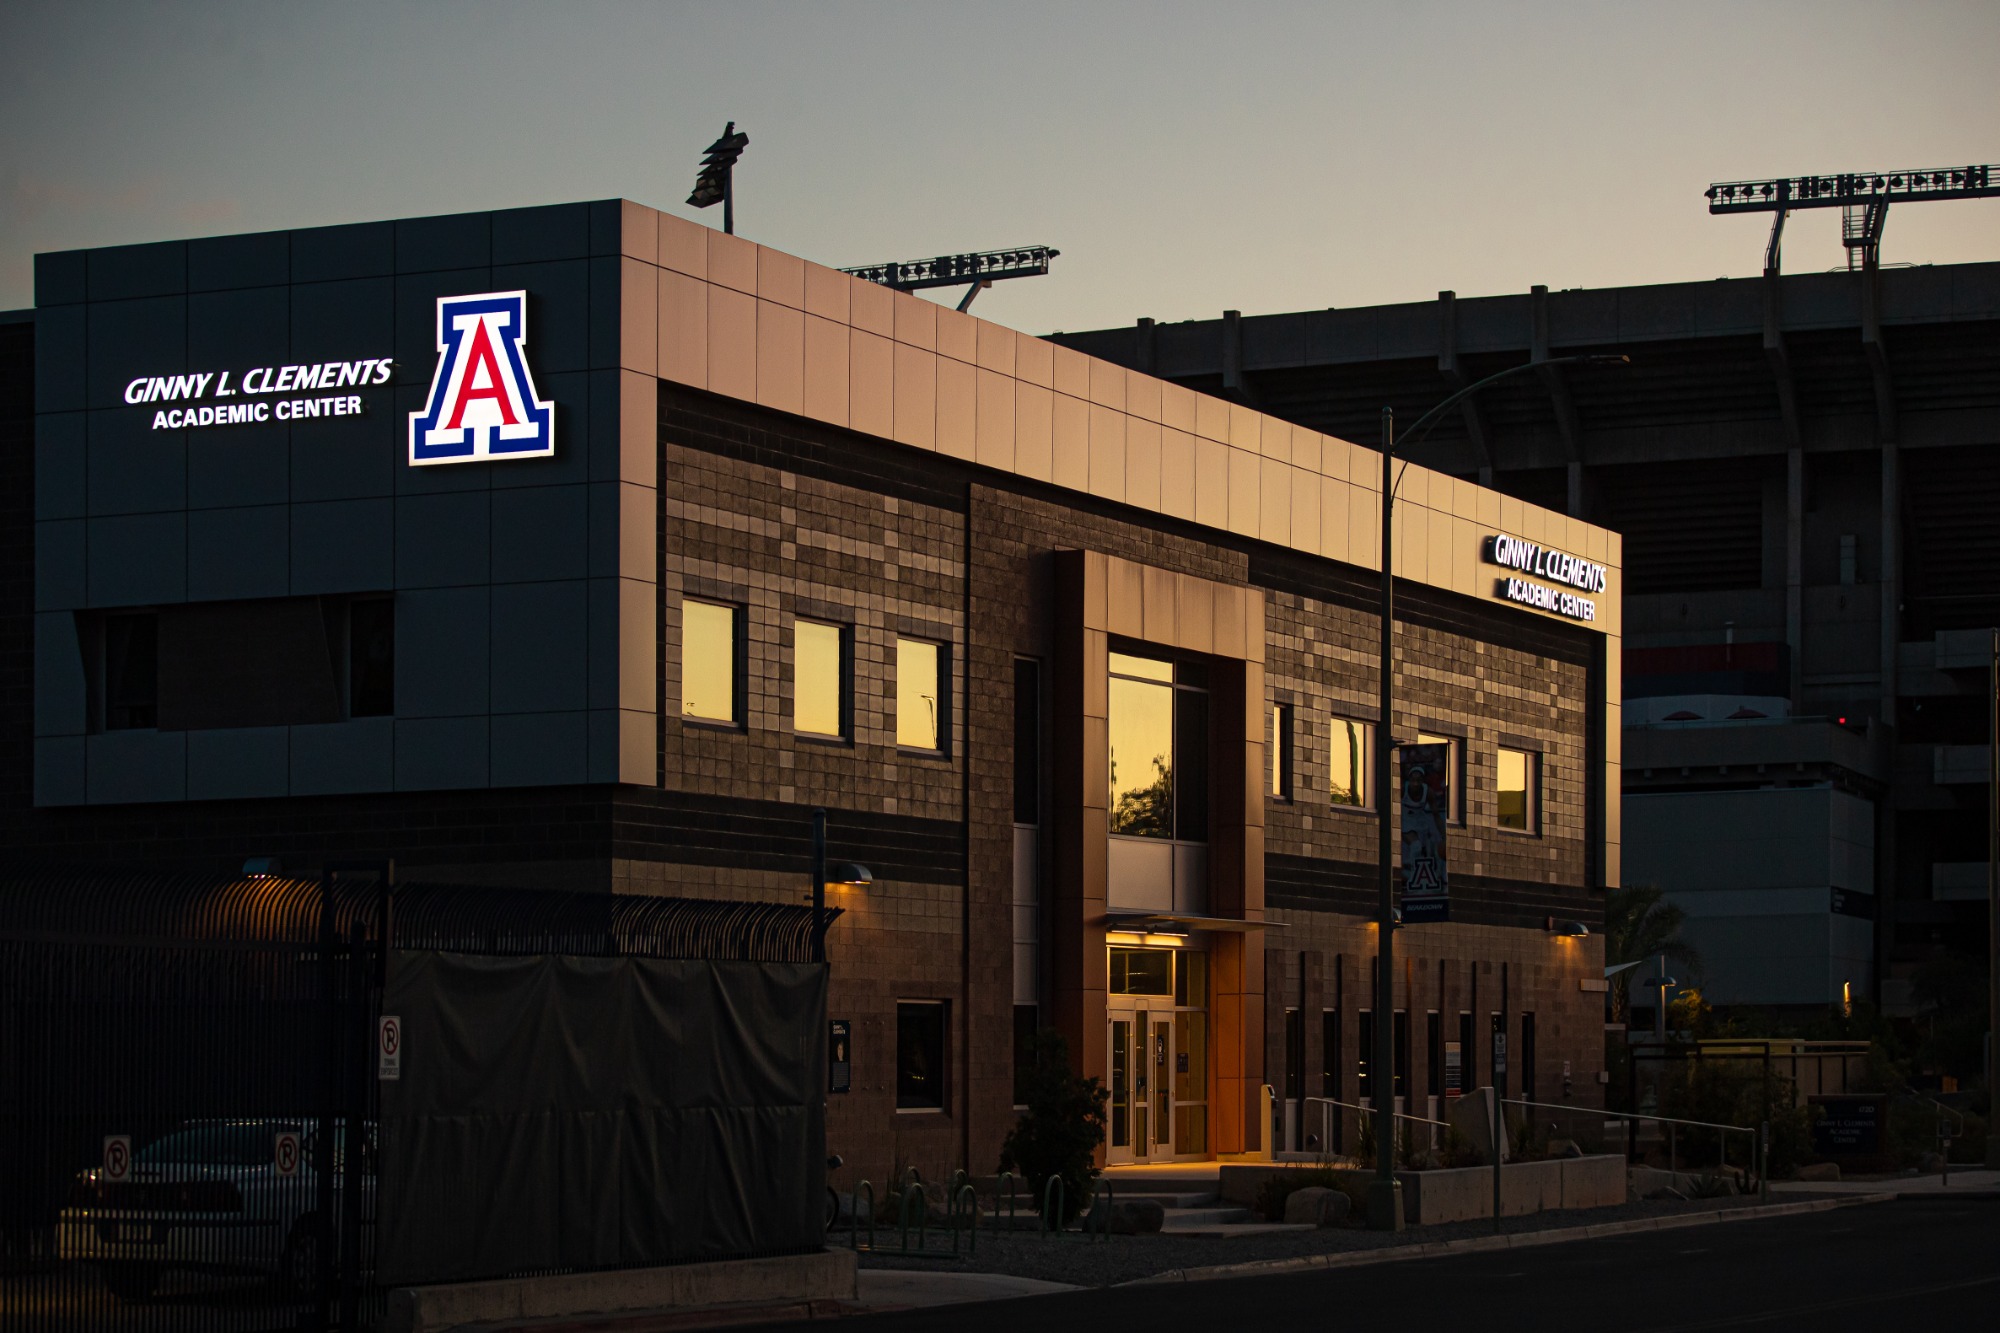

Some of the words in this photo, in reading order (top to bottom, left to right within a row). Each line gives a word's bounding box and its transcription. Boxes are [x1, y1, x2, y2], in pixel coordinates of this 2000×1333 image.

[125, 372, 213, 403] GINNY
[215, 371, 236, 396] L.
[242, 358, 393, 394] CLEMENTS
[409, 290, 554, 466] A
[152, 403, 269, 429] ACADEMIC
[275, 395, 362, 420] CENTER
[1495, 534, 1535, 571] GINNY
[1535, 546, 1545, 576] L.
[1546, 550, 1606, 593] CLEMENTS
[1507, 577, 1559, 612] ACADEMIC
[1560, 593, 1595, 621] CENTER
[1407, 857, 1441, 890] A
